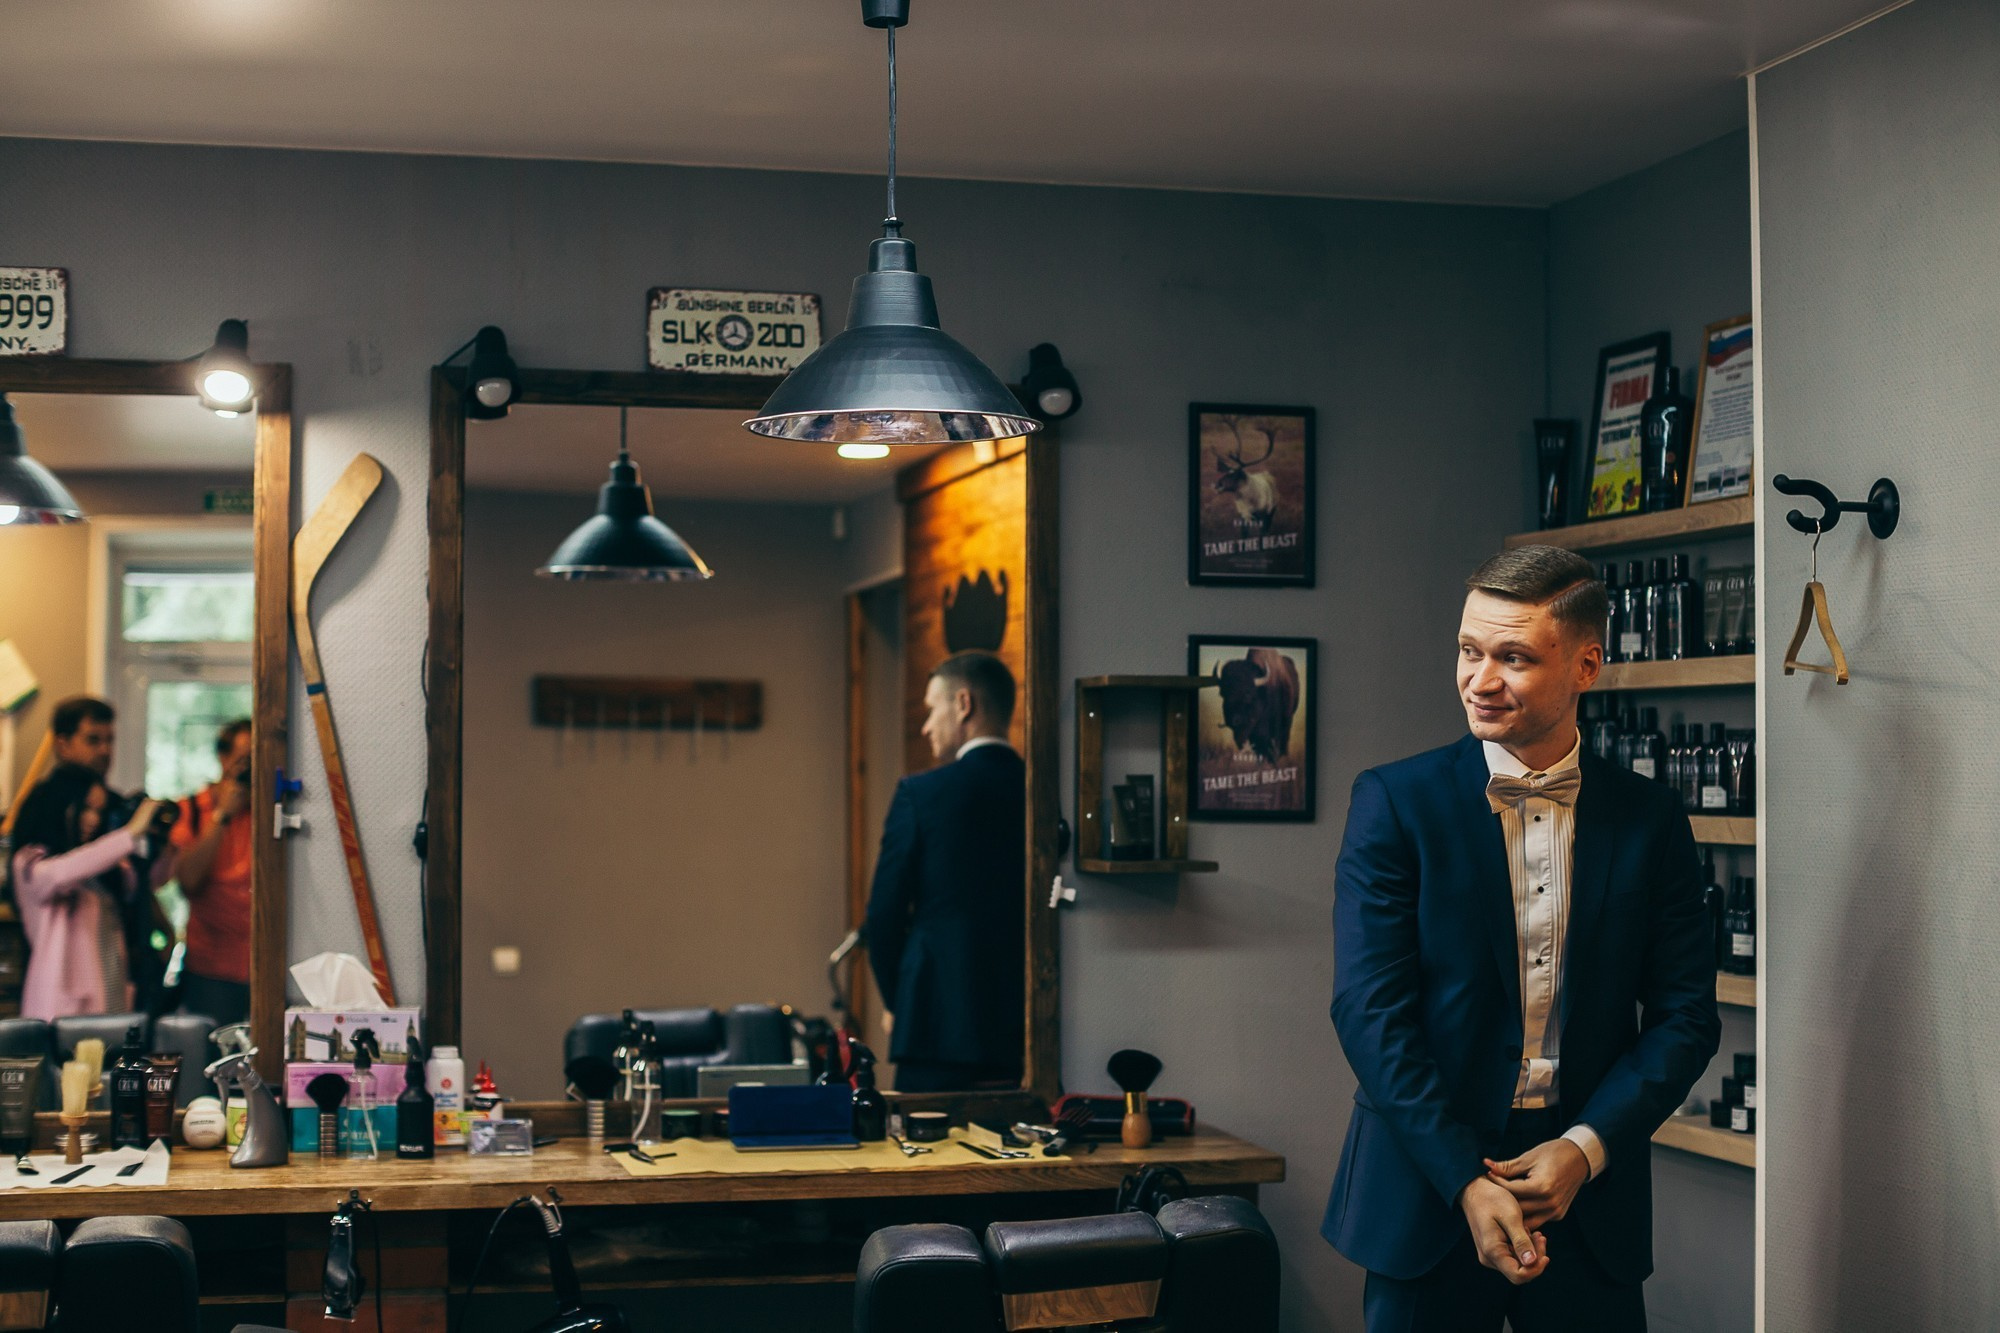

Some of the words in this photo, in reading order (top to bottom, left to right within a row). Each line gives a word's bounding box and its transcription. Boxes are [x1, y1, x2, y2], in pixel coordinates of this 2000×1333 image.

[0, 278, 41, 290] SCHE
[0, 294, 53, 329] 999
[677, 299, 743, 312] SUNSHINE
[747, 301, 795, 314] BERLIN
[662, 320, 712, 344] SLK
[757, 322, 805, 348] 200
[0, 336, 28, 350] NY
[685, 353, 788, 369] GERMANY
[1204, 540, 1234, 556] TAME
[1237, 537, 1259, 552] THE
[1262, 533, 1297, 550] BEAST
[1204, 774, 1234, 791] TAME
[1237, 771, 1259, 786] THE
[1262, 767, 1297, 784] BEAST
[118, 1078, 139, 1091] CREW
[147, 1078, 172, 1091] CREW
